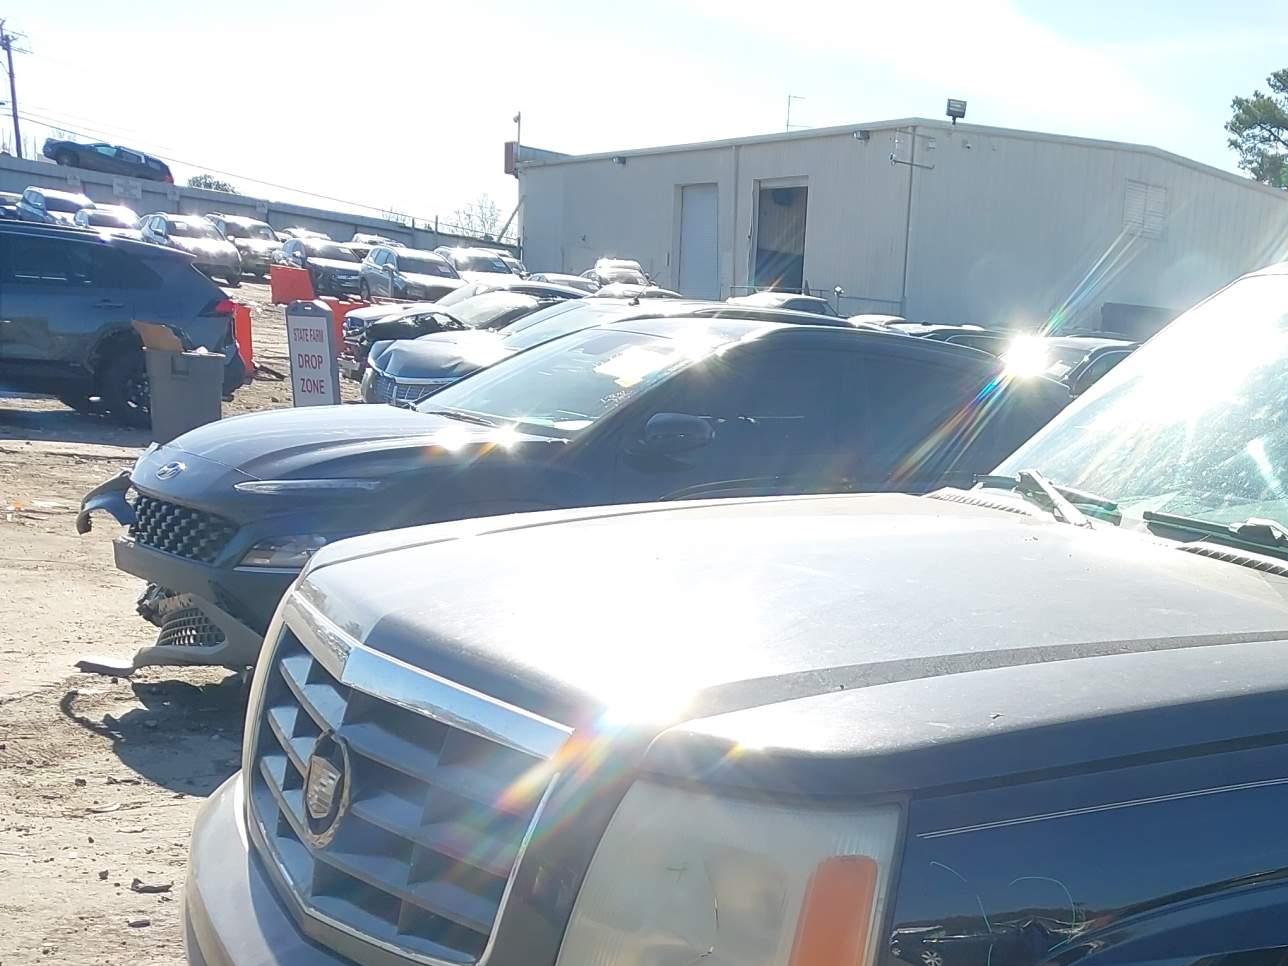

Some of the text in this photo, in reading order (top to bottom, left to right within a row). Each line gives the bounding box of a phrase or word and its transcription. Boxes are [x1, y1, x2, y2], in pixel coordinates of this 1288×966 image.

[293, 328, 324, 343] STATE FARM
[298, 354, 323, 369] DROP
[300, 378, 325, 394] ZONE
